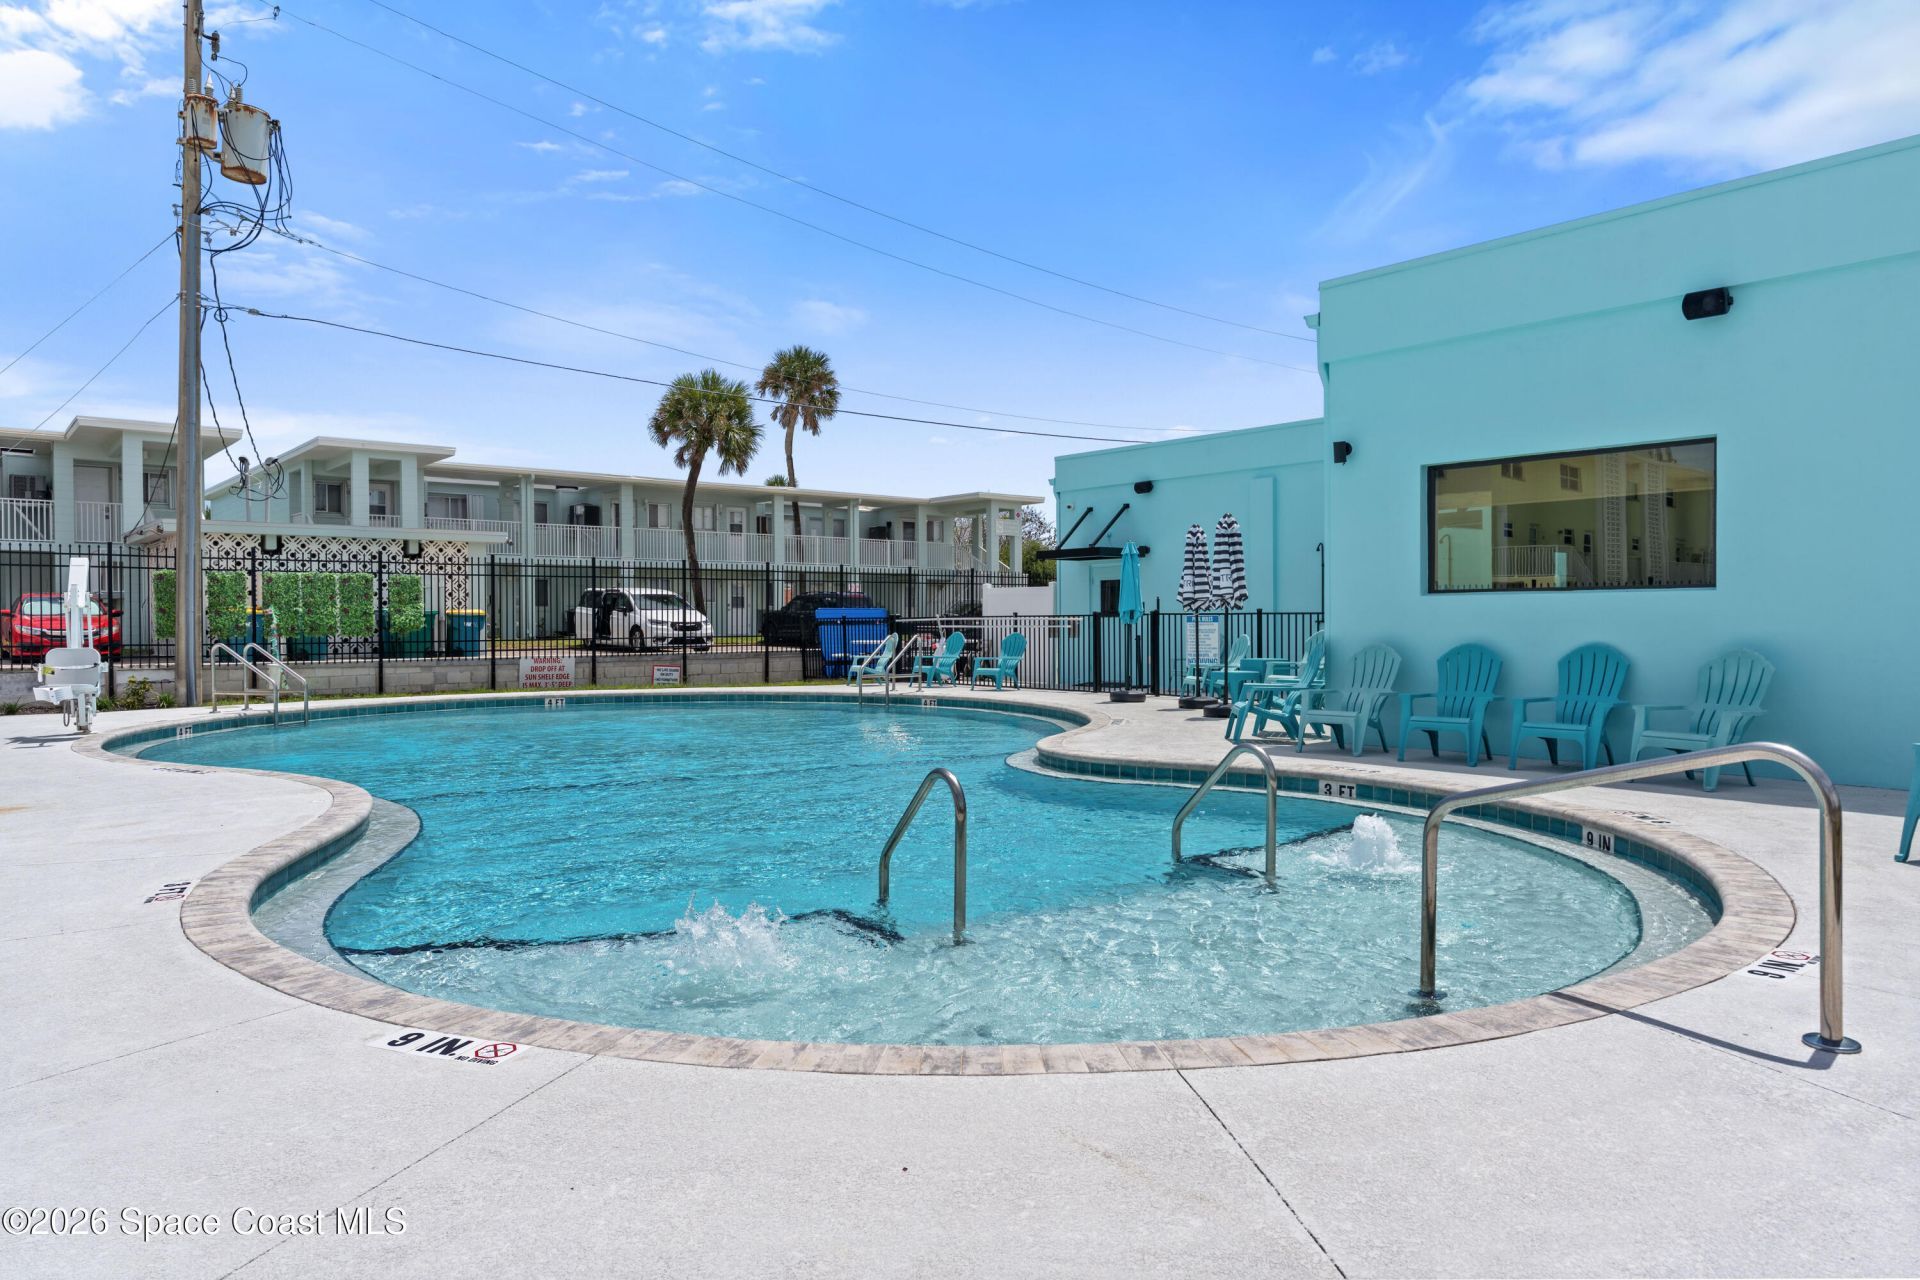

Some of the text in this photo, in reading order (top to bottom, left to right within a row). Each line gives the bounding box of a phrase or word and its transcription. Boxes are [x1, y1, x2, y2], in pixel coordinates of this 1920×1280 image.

[185, 726, 192, 735] FT
[1324, 783, 1355, 798] 3 FT
[1586, 831, 1611, 851] 9 IN
[1747, 969, 1786, 979] 9
[387, 1032, 474, 1056] 9 IN.
